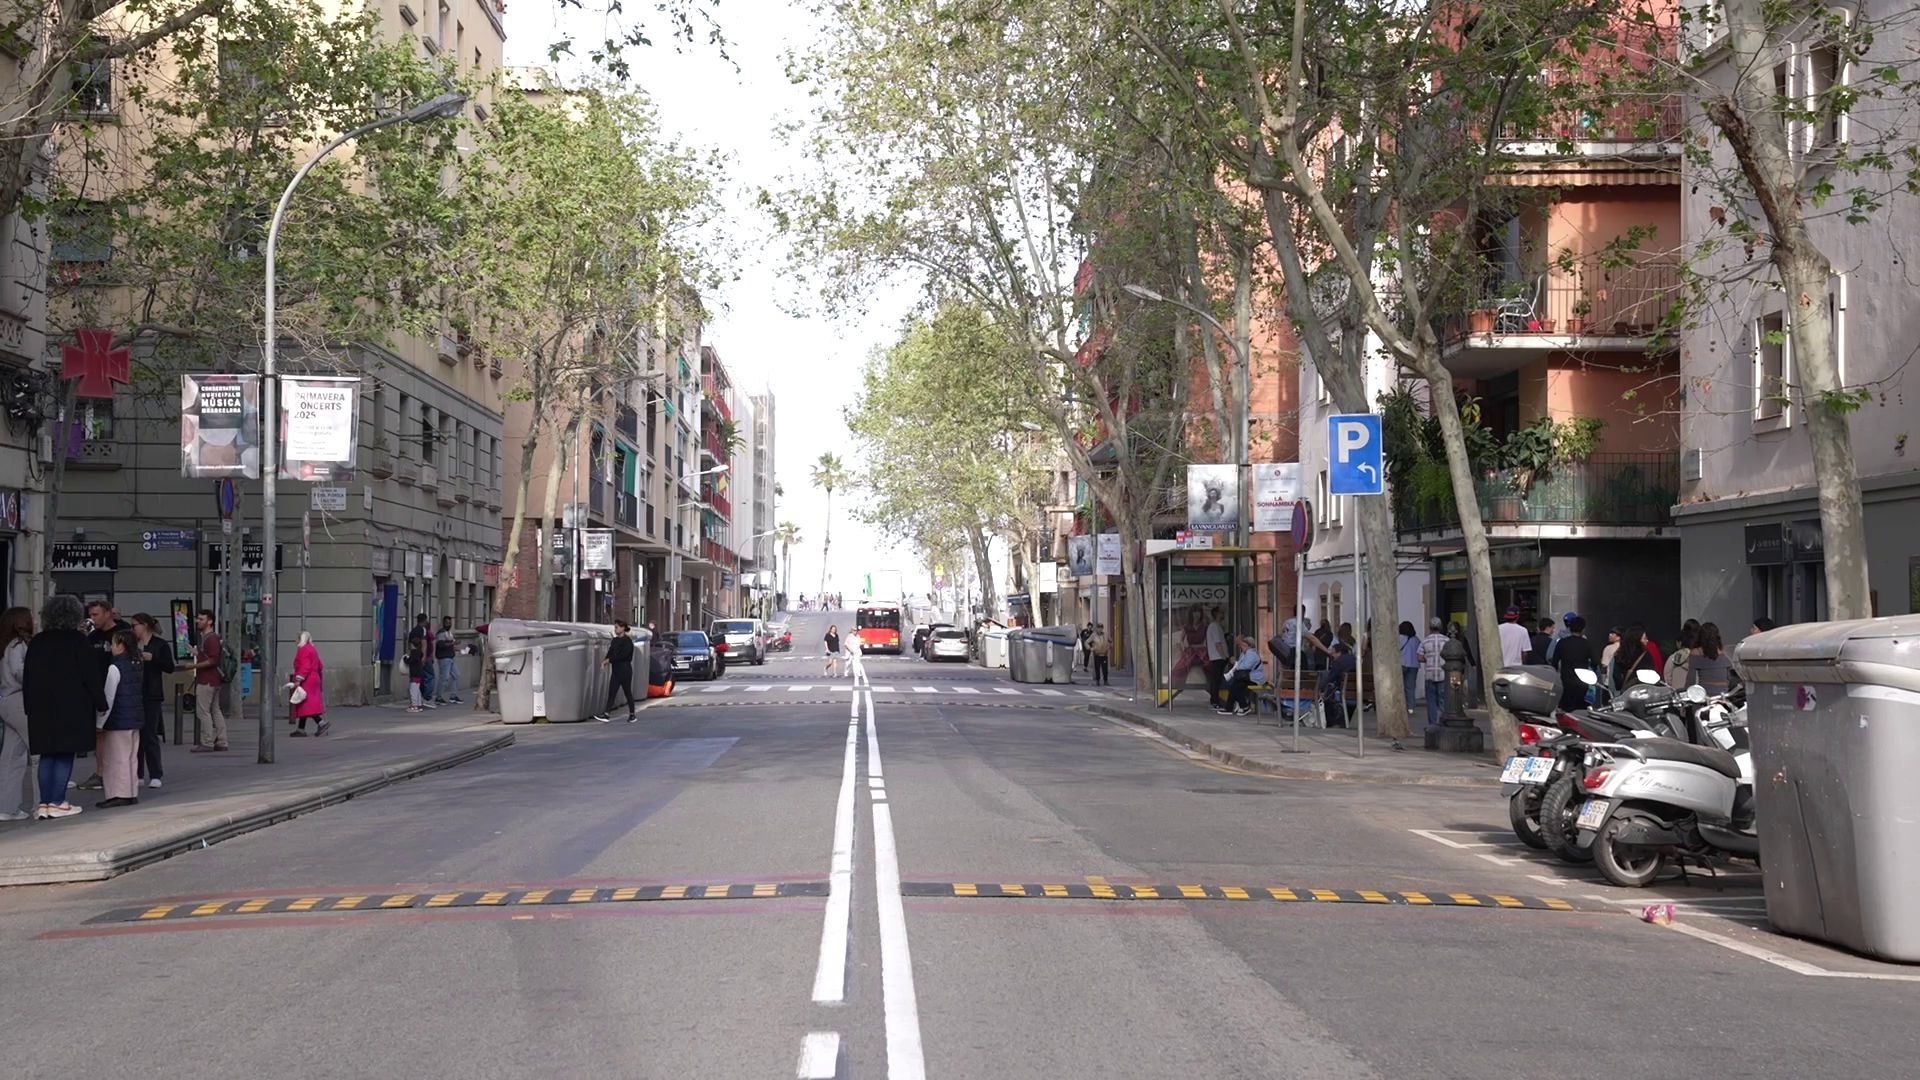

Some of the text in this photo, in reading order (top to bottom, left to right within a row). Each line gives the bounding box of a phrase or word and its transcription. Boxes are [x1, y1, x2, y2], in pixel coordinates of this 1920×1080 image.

[295, 391, 345, 401] PRIMAVERA
[201, 396, 241, 407] MÚSICA
[296, 401, 342, 410] ONCERTS
[294, 411, 316, 419] 2025
[1338, 422, 1370, 463] P
[1164, 588, 1226, 599] MANGO
